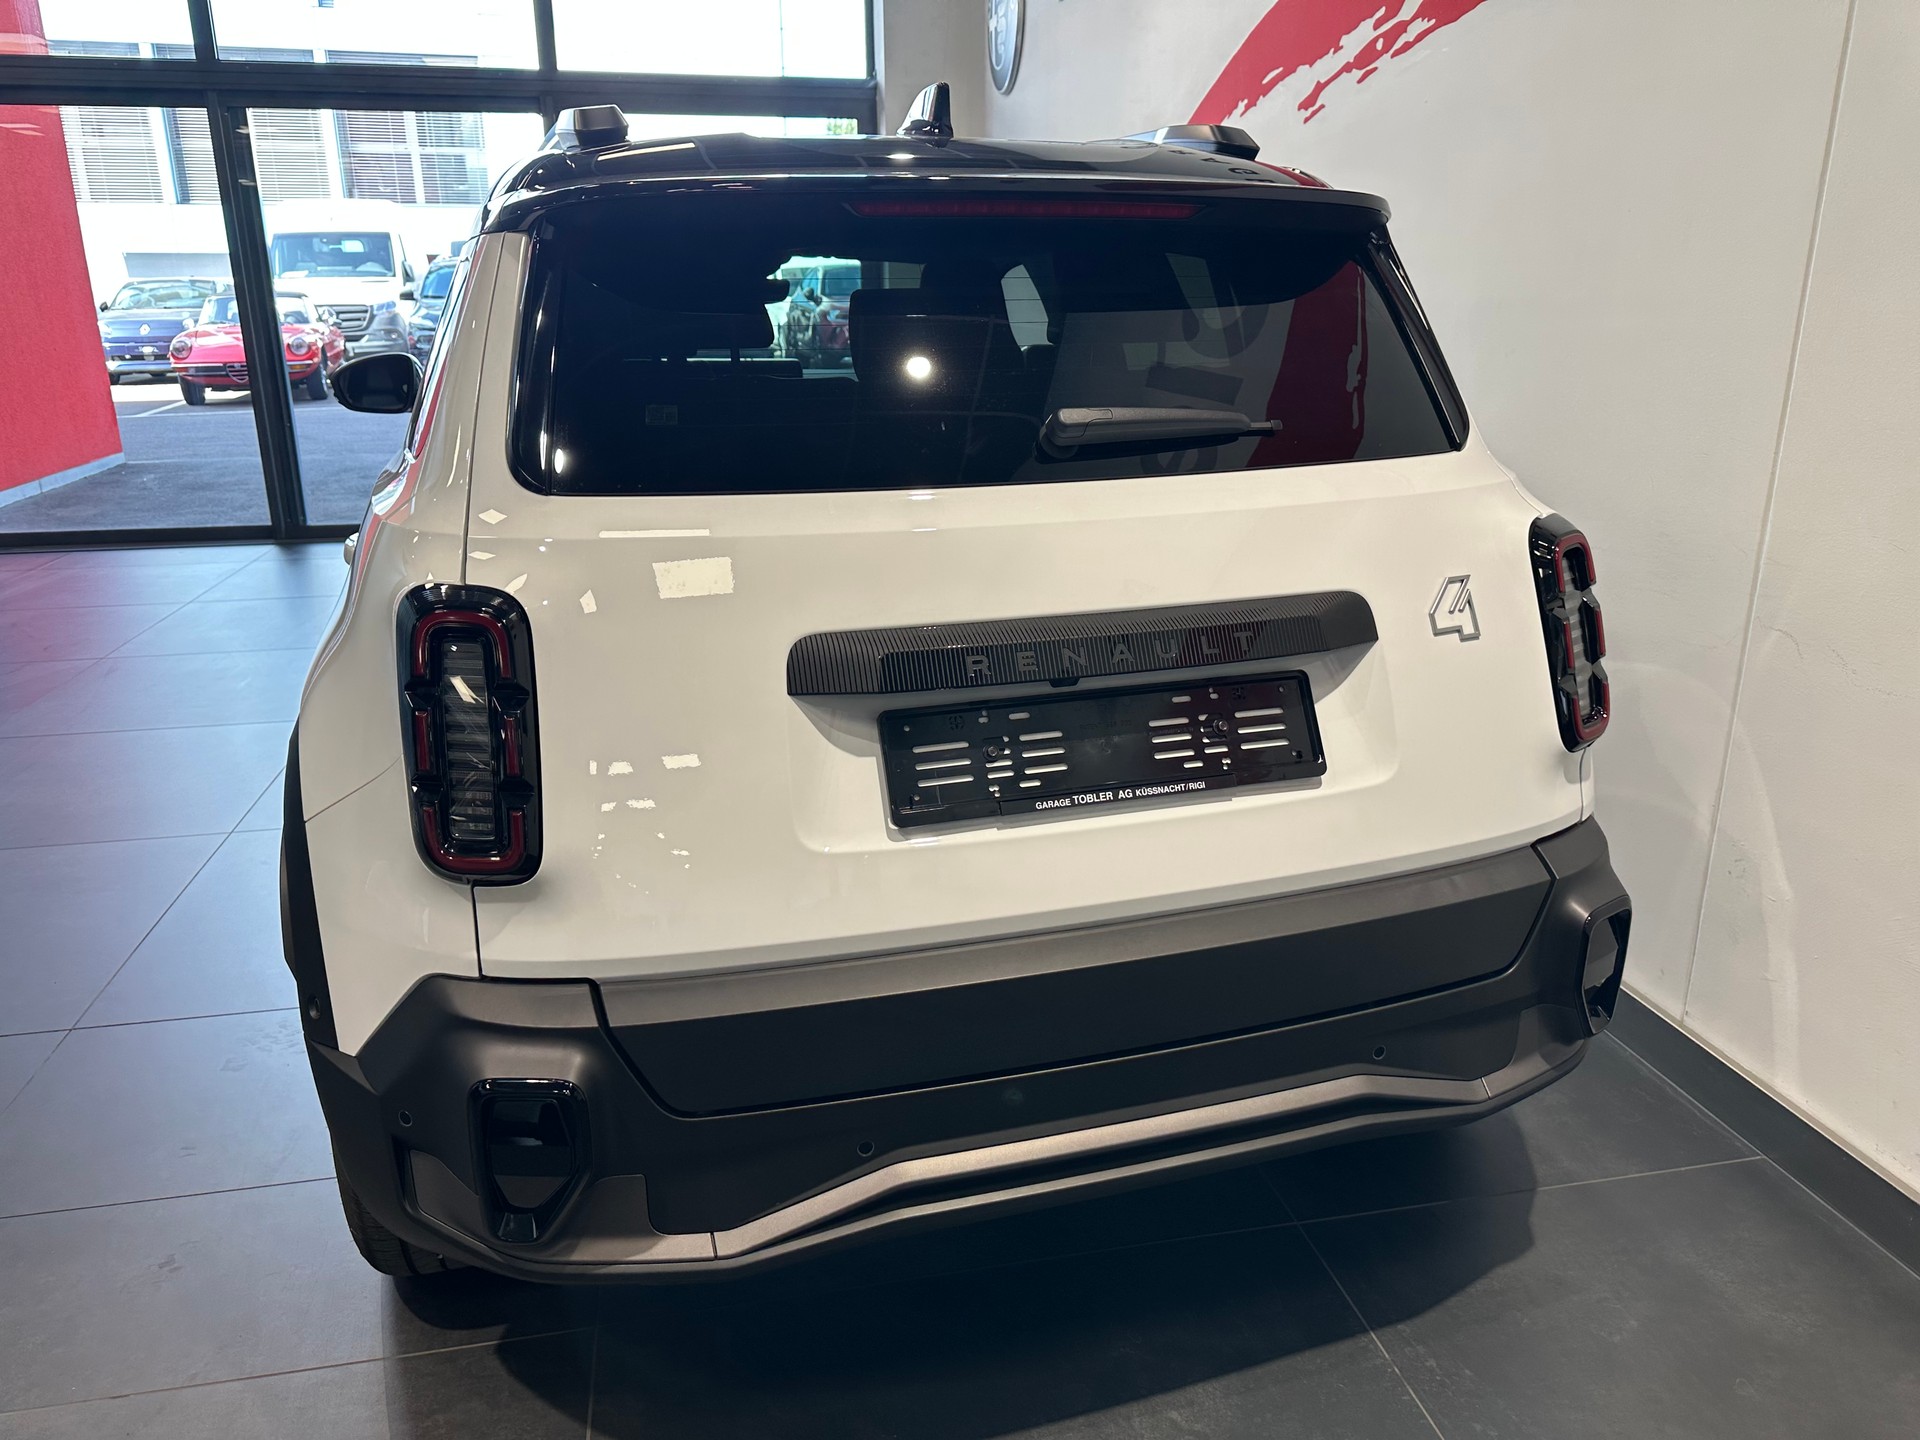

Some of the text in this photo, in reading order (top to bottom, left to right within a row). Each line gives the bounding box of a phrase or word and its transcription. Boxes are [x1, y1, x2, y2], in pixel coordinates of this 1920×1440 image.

[1428, 574, 1481, 642] 4
[965, 630, 1254, 677] RENAULT
[1035, 781, 1206, 810] GARAGE TOBLER AG KÜSSNACHT/RIGI
